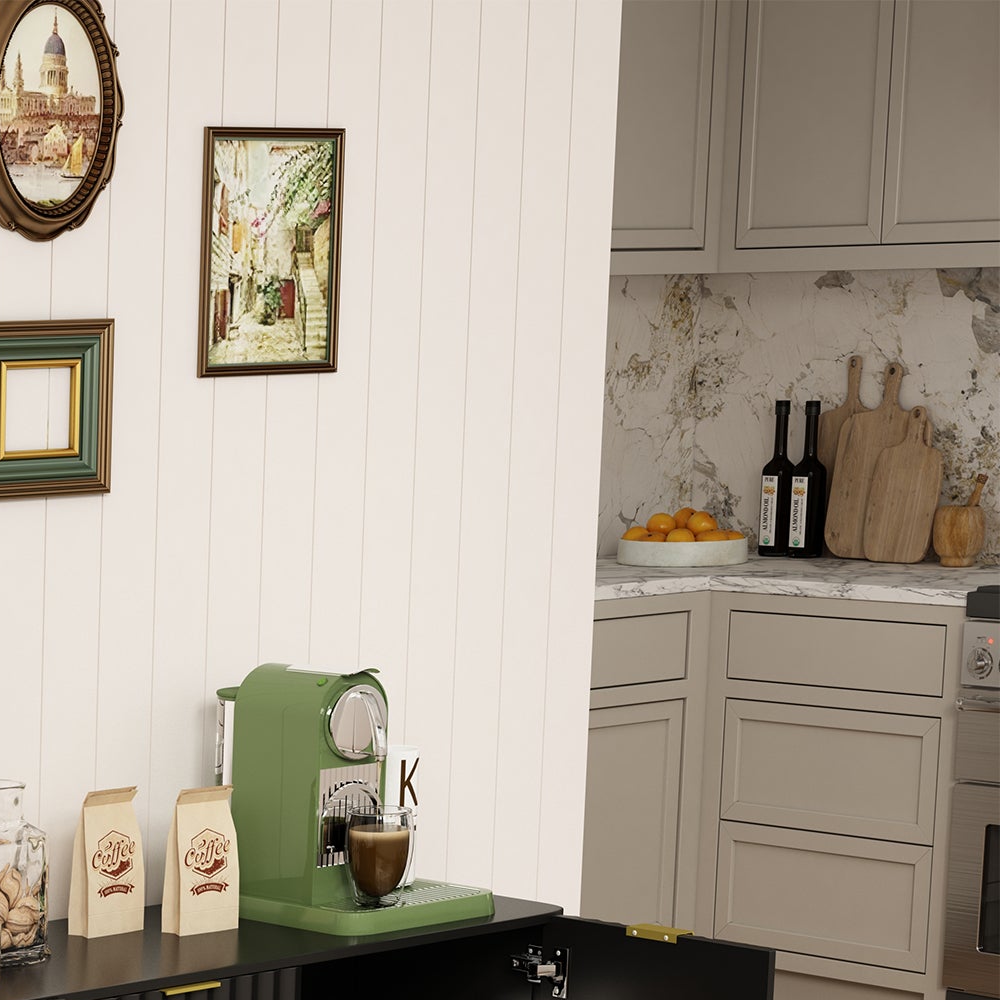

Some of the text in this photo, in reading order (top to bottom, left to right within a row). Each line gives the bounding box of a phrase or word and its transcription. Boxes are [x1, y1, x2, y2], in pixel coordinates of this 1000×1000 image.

[400, 757, 419, 807] K
[92, 840, 135, 870] Coffee
[185, 838, 230, 868] Coffee
